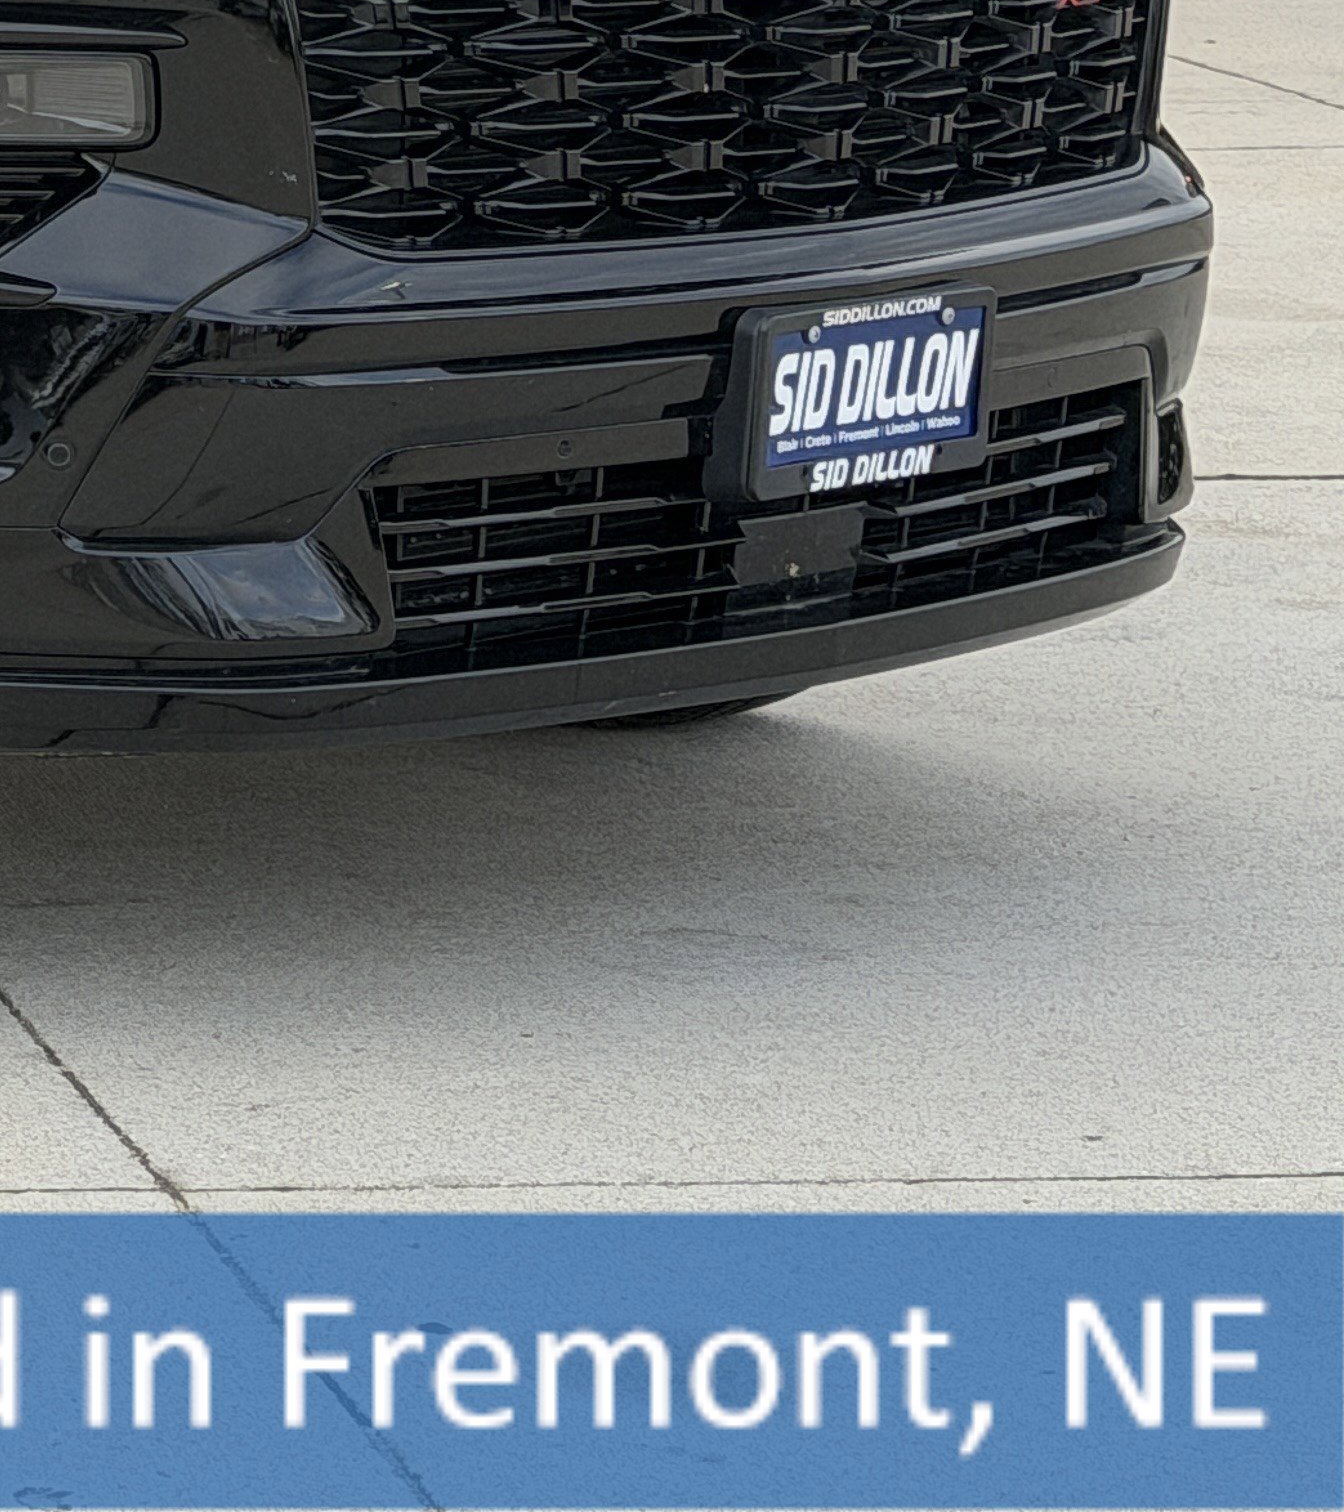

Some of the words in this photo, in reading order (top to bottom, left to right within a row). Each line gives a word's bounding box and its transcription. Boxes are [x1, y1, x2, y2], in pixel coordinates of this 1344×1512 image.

[822, 296, 942, 327] SIDDILLON.COM
[769, 347, 836, 436] SID
[836, 328, 980, 426] DILLON
[838, 426, 880, 444] Fremont
[885, 420, 920, 436] Lincoln
[809, 458, 850, 493] SID
[852, 444, 935, 486] DILLON
